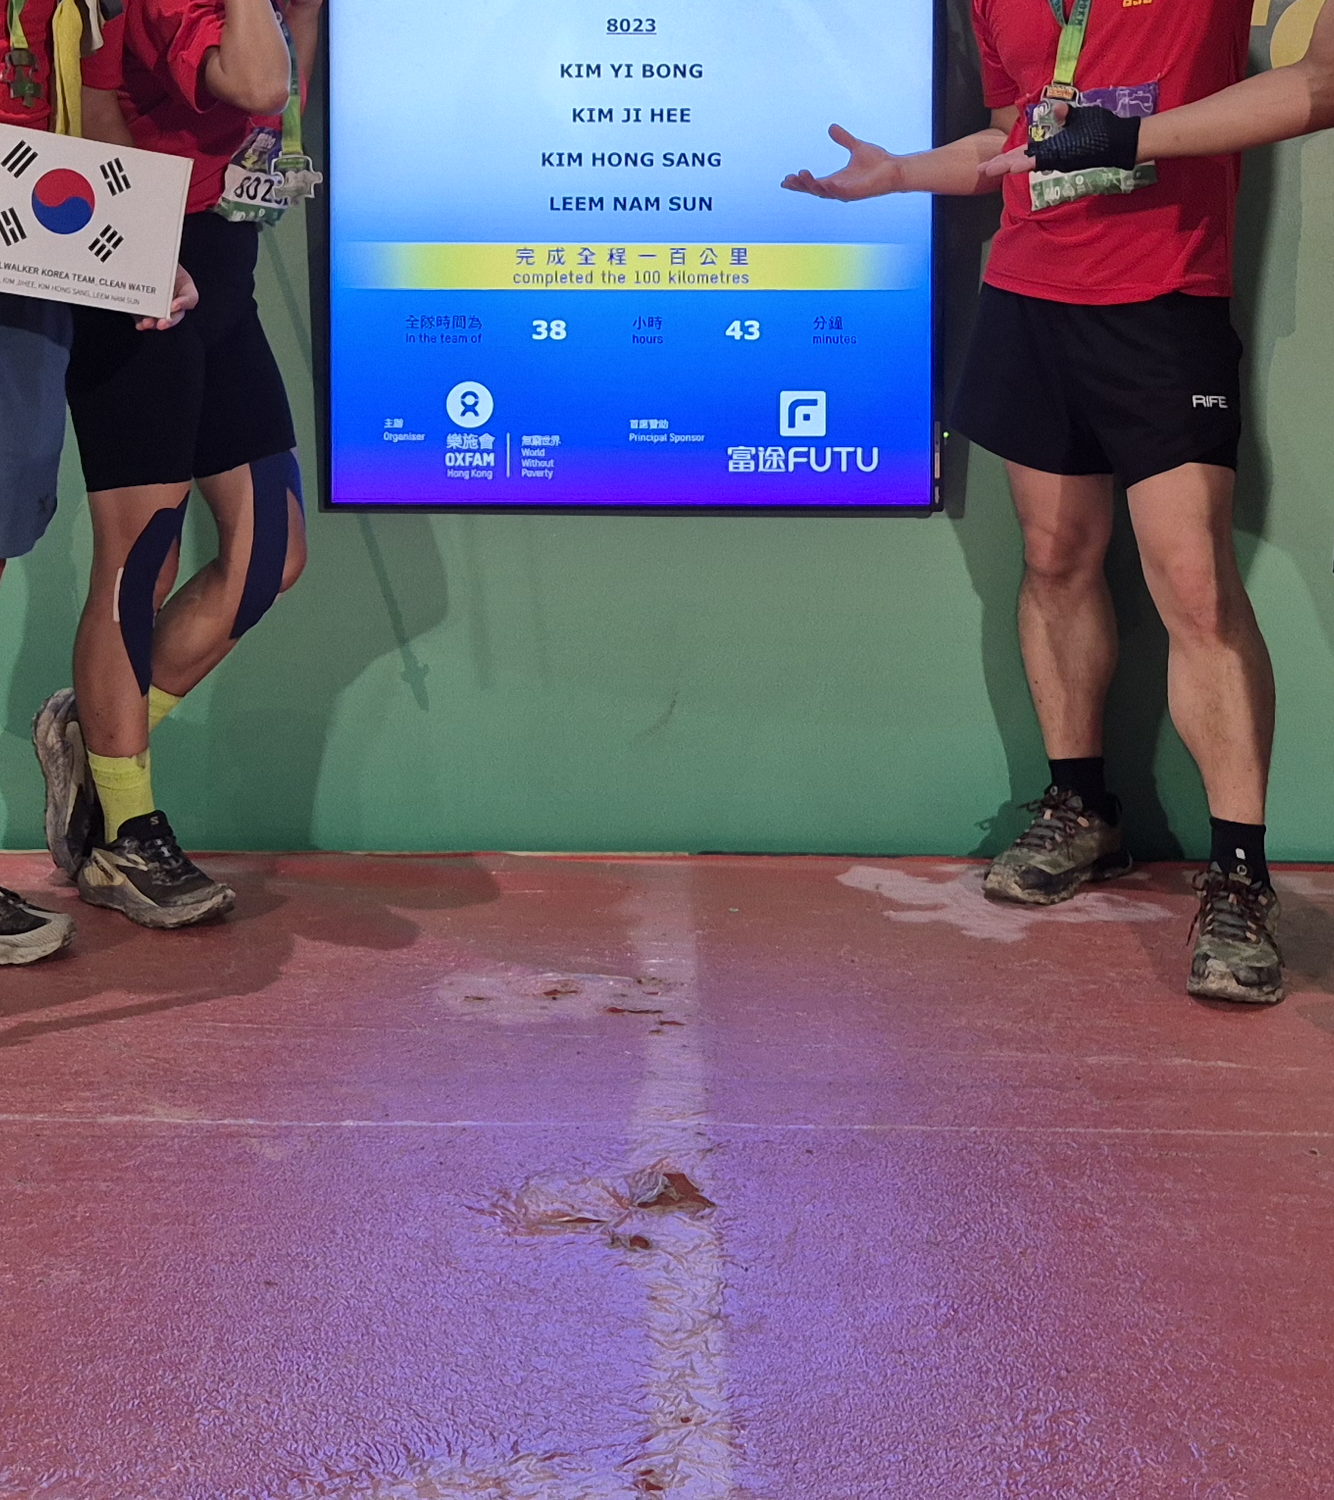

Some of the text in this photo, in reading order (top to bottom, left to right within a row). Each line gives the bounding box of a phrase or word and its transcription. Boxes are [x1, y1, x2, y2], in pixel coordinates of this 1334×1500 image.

[606, 18, 657, 34] 8023
[560, 63, 704, 79] KIM YI BONG
[572, 108, 692, 123] KIM JI HEE
[541, 152, 723, 168] KIM HONG SANG
[233, 175, 288, 206] 802
[549, 197, 713, 212] LEEM NAM SUN
[515, 247, 750, 266] 完成全程一百公里
[41, 267, 70, 280] KOREA
[128, 281, 157, 295] WATER
[513, 269, 750, 287] completed the 100 kilometres
[405, 314, 483, 330] 全隊時間為
[531, 319, 567, 340] 38
[632, 315, 663, 330] 小時
[724, 319, 761, 340] 43
[812, 315, 844, 330] 分鐘
[418, 332, 437, 344] the
[440, 332, 468, 344] team
[470, 332, 483, 344] of
[632, 333, 664, 344] hours
[812, 333, 857, 344] minutes
[383, 431, 425, 443] Organiser
[446, 432, 496, 450] 樂施會
[628, 432, 706, 444] Principal Sponsor
[445, 451, 495, 467] OXFAM
[521, 448, 546, 458] World
[521, 458, 555, 468] Without
[447, 468, 493, 480] Hong Kong
[521, 468, 554, 480] Poverty
